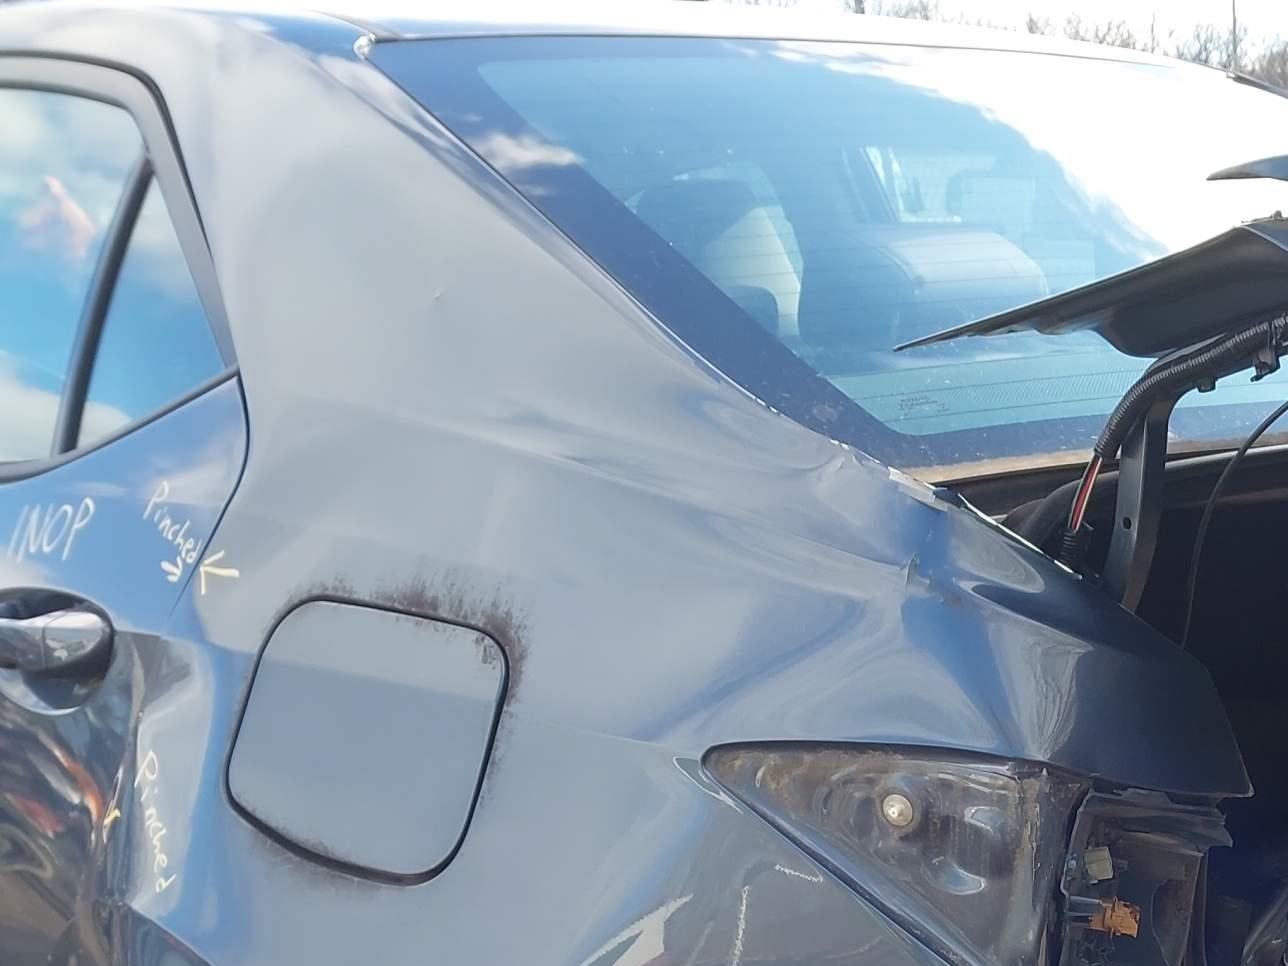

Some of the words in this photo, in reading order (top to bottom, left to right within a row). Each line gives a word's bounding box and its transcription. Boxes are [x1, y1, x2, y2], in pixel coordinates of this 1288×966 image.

[7, 496, 96, 563] INOP
[142, 480, 202, 564] Pinched
[133, 749, 177, 893] Pinched
